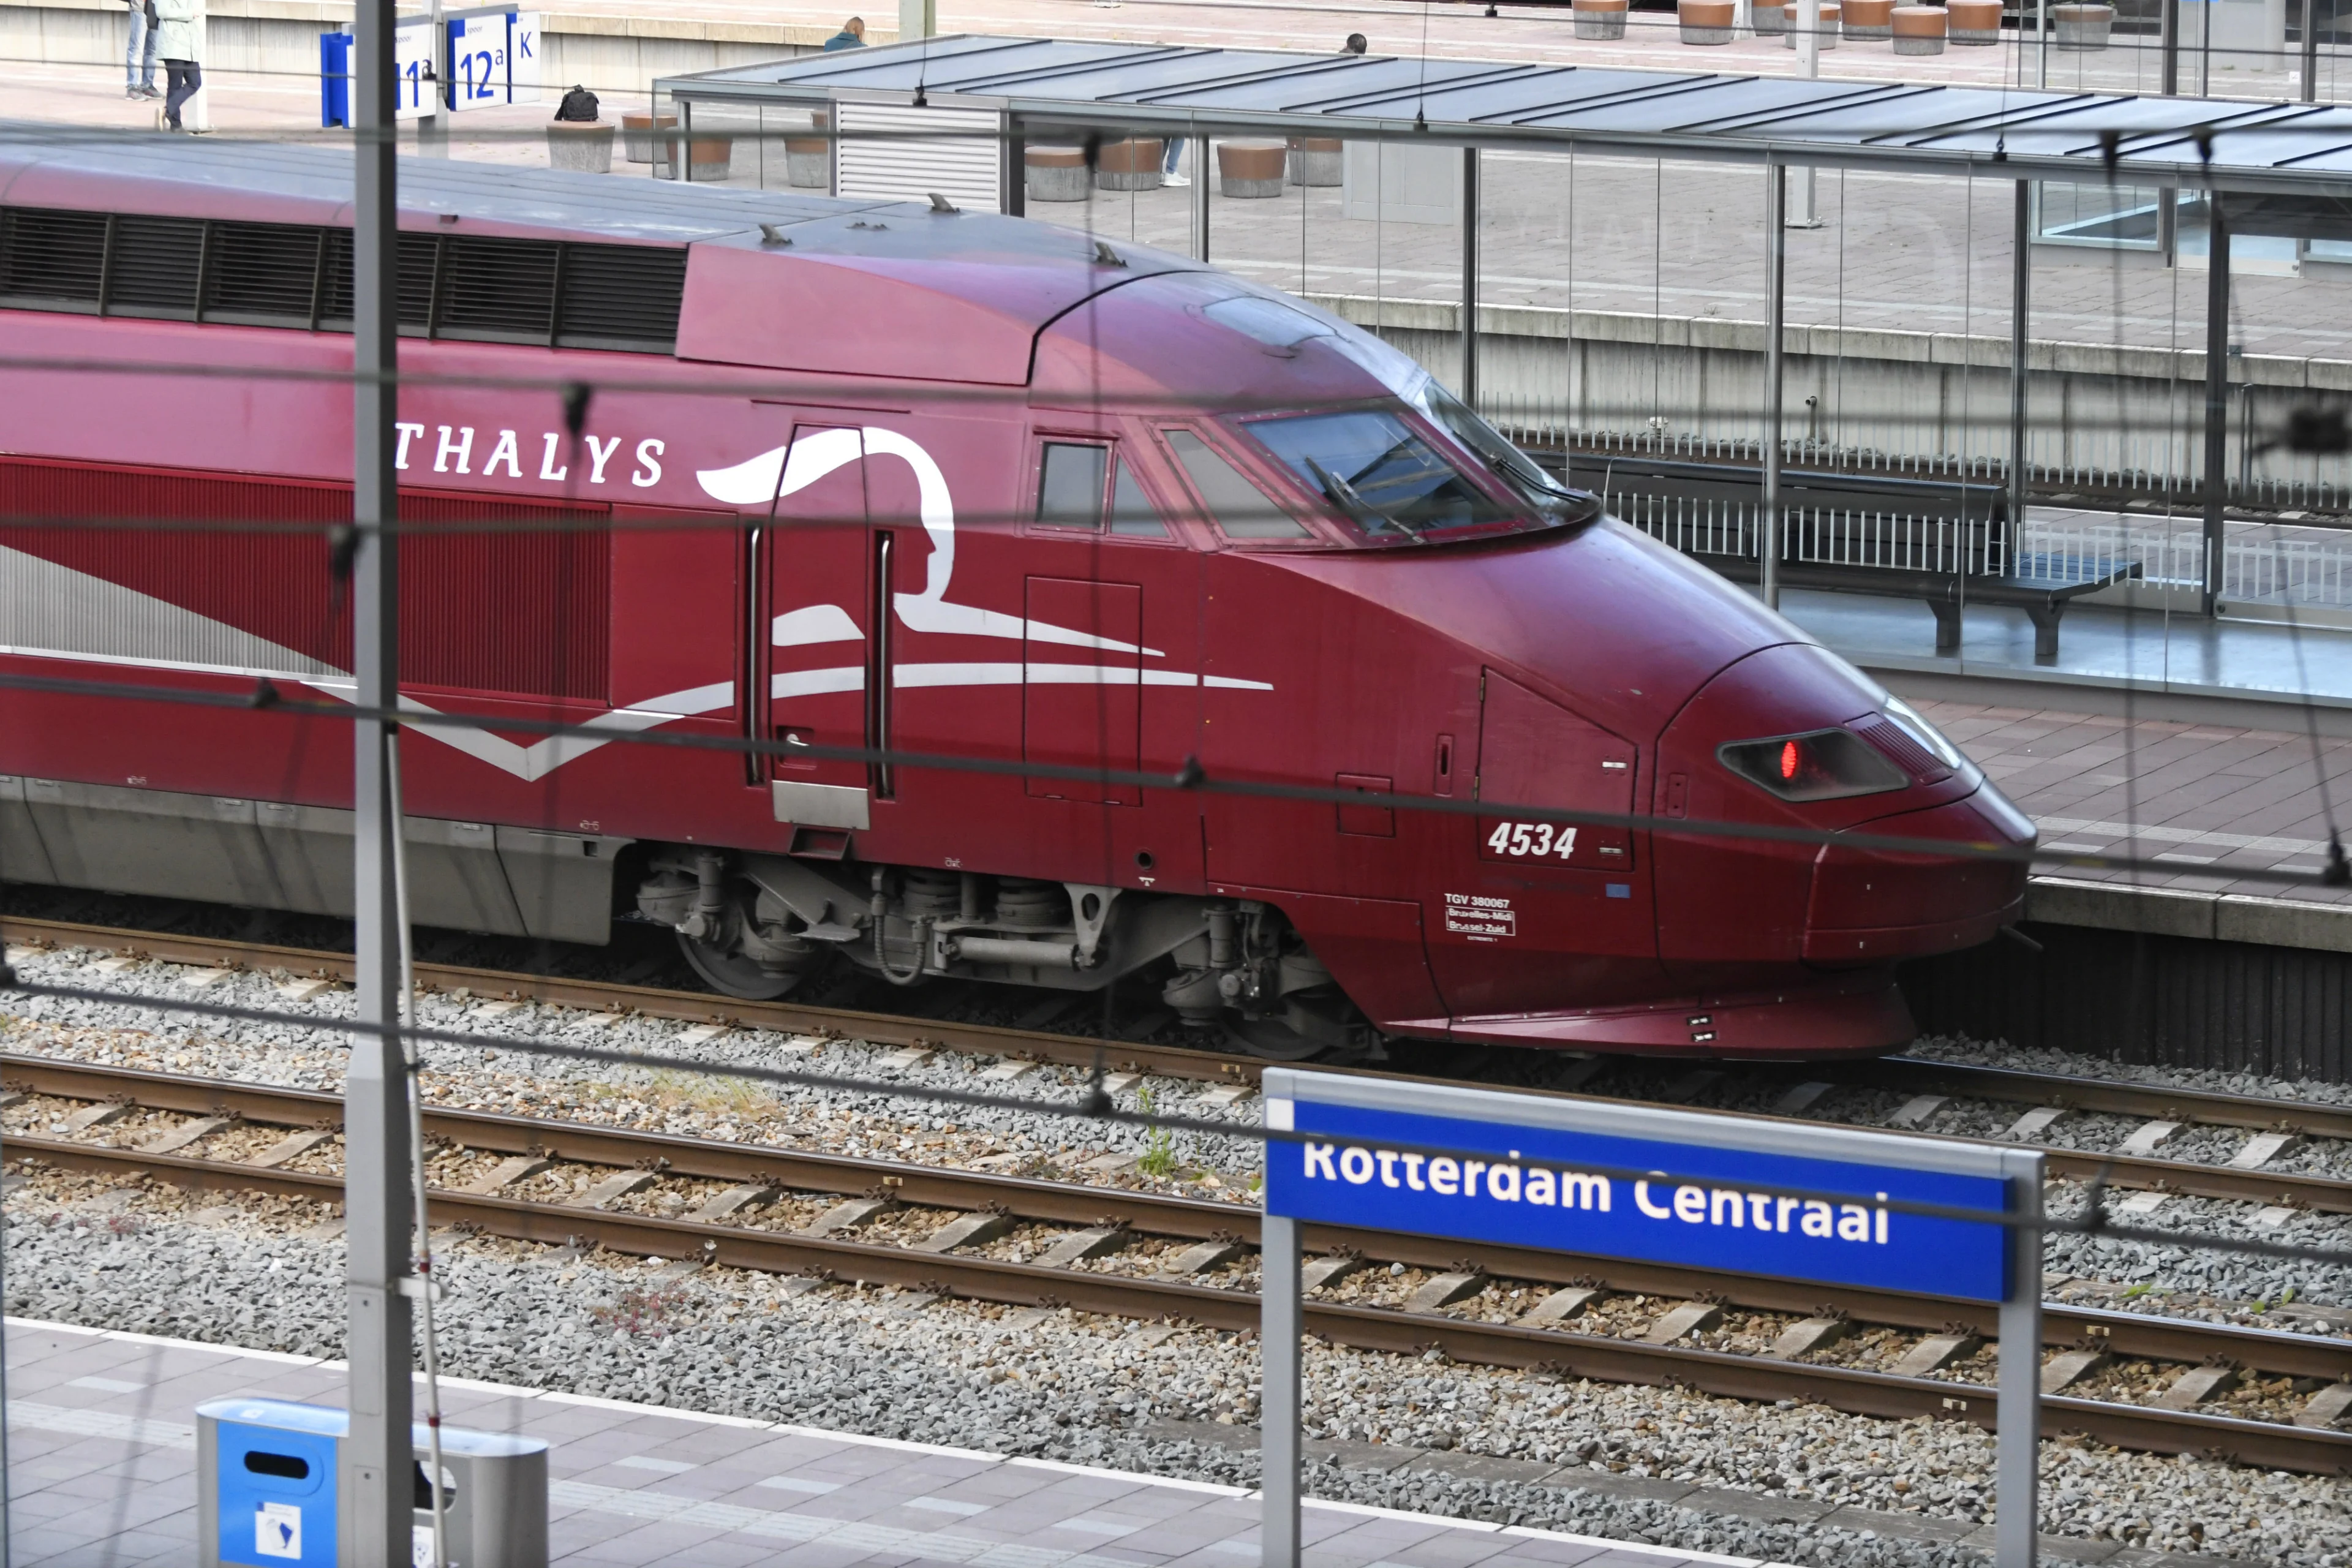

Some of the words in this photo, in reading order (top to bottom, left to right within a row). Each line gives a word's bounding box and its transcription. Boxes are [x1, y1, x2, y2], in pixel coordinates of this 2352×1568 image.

[521, 31, 533, 59] K
[394, 423, 665, 488] THALYS
[1487, 822, 1578, 859] 4534
[1444, 893, 1469, 905] TGV
[1471, 896, 1510, 908] 380067
[1303, 1133, 1611, 1212] Rotterdam
